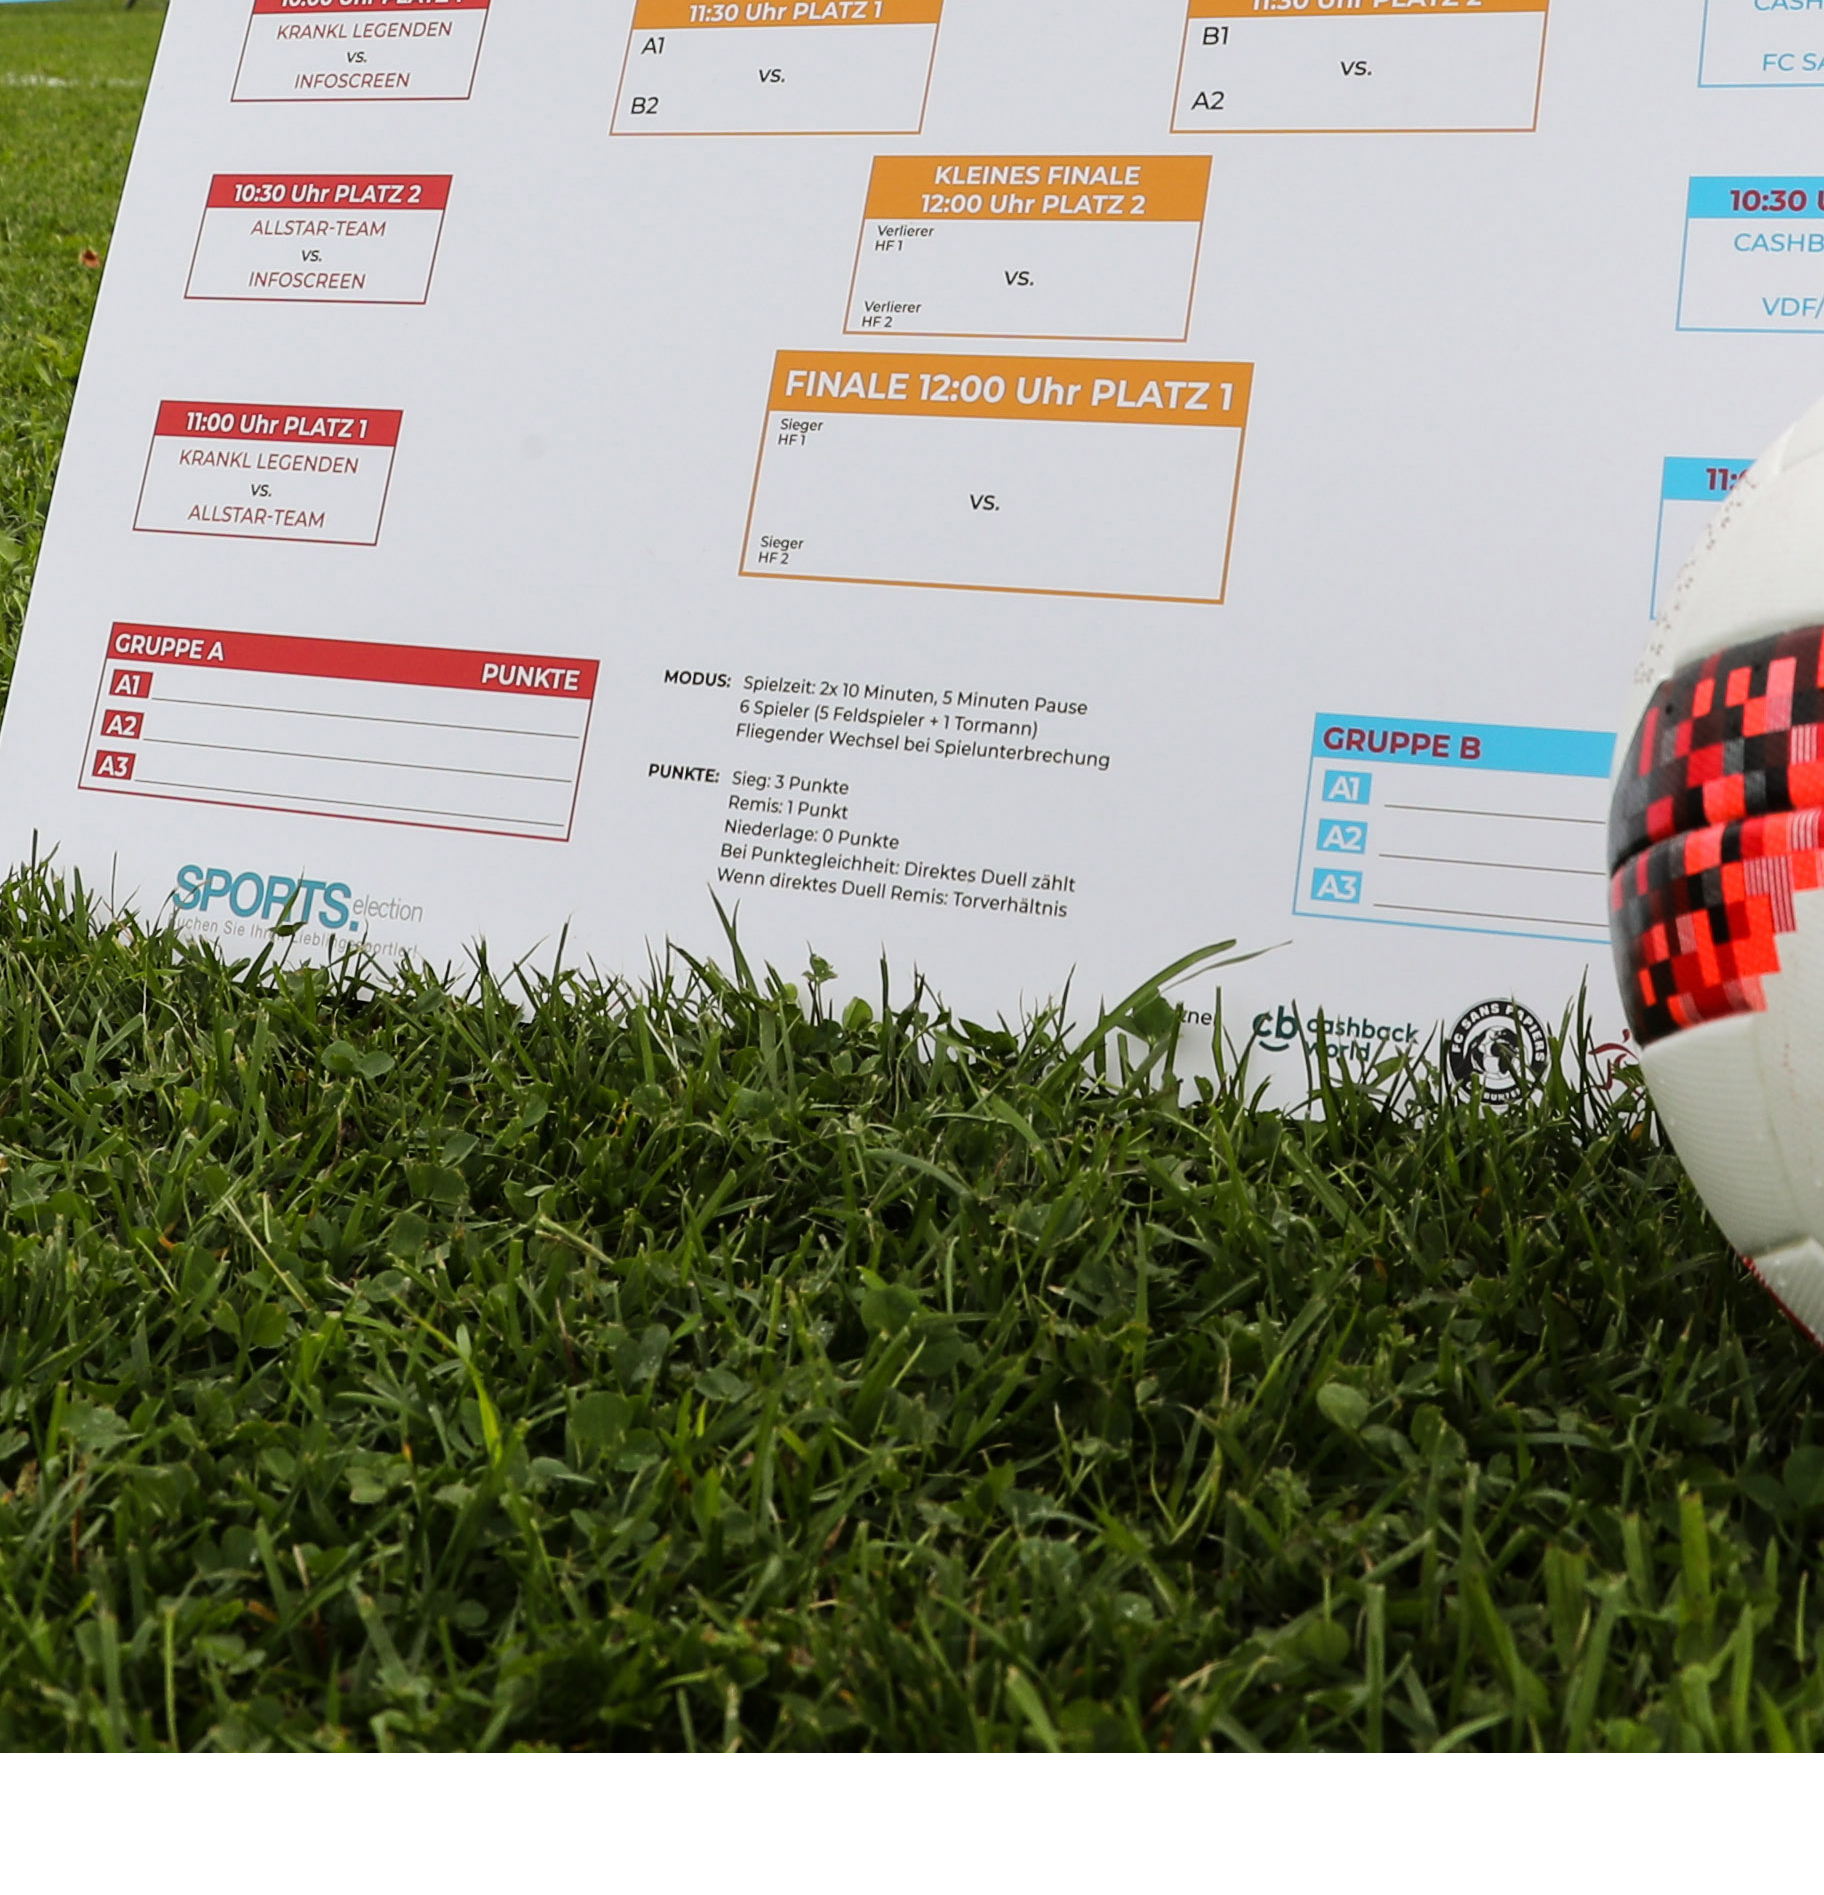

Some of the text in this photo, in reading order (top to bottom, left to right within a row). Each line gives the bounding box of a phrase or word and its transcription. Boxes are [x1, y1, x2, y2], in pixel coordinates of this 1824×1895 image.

[690, 0, 884, 22] 11:30 Uhr PLATZ 1
[277, 22, 452, 39] KRANKL LEGENDEN
[1763, 53, 1794, 71] FC
[295, 73, 410, 88] INFOSCREEN
[935, 166, 1141, 185] KLEINES FINALE
[235, 184, 422, 202] 10:30 Uhr PLATZ 2
[922, 194, 1146, 214] 12:00 Uhr PLATZ 2
[1730, 190, 1806, 211] 10:30
[786, 370, 1234, 410] FINALE 12:00 Uhr PLATZ 1
[188, 412, 369, 439] 11:00 Uhr PLATZ 1
[116, 634, 224, 660] GRUPPE A
[482, 664, 580, 690] PUNKTE
[665, 670, 730, 687] MODUS:
[744, 676, 1087, 715] Spielzeit: 2x 10 Minuten, 5 Minuten Pause
[739, 699, 1037, 739] 6 Spieler (5 Feldspieler + 1 Tormann)
[737, 723, 1109, 770] Fliegender Wechsel bei Spielunterbrechung
[1324, 728, 1480, 759] GRUPPE B
[649, 764, 719, 782] PUNKTE:
[733, 771, 848, 794] Sieg: 3 Punkte
[729, 795, 848, 819] Remis: 1 Punkt
[725, 819, 899, 849] Niederlage: 0 Punkte
[721, 843, 1075, 892] Bei Punktegleichheit: Direktes Duell zählt
[718, 868, 1067, 917] Wenn direktes Duell Remis: Torverhältnis
[1461, 1002, 1500, 1030] SANS
